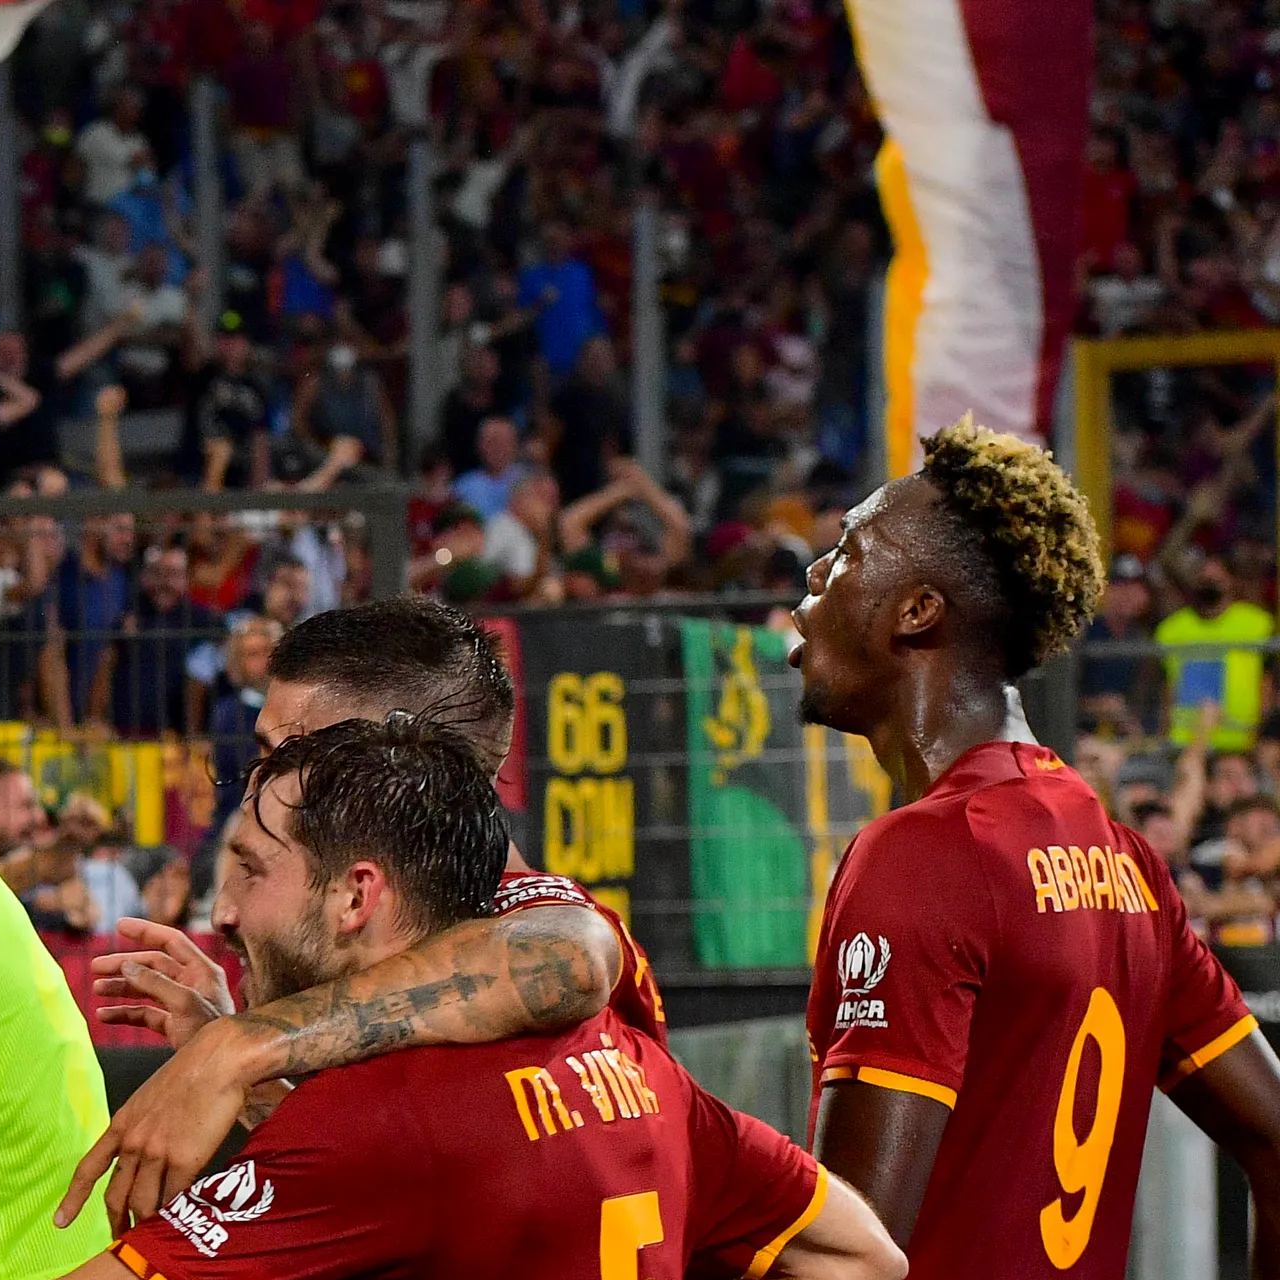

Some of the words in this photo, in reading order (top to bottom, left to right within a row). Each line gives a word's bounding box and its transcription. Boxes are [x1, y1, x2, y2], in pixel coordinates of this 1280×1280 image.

[548, 671, 629, 776] 66
[1040, 987, 1126, 1270] 9
[166, 1191, 229, 1250] NHCR
